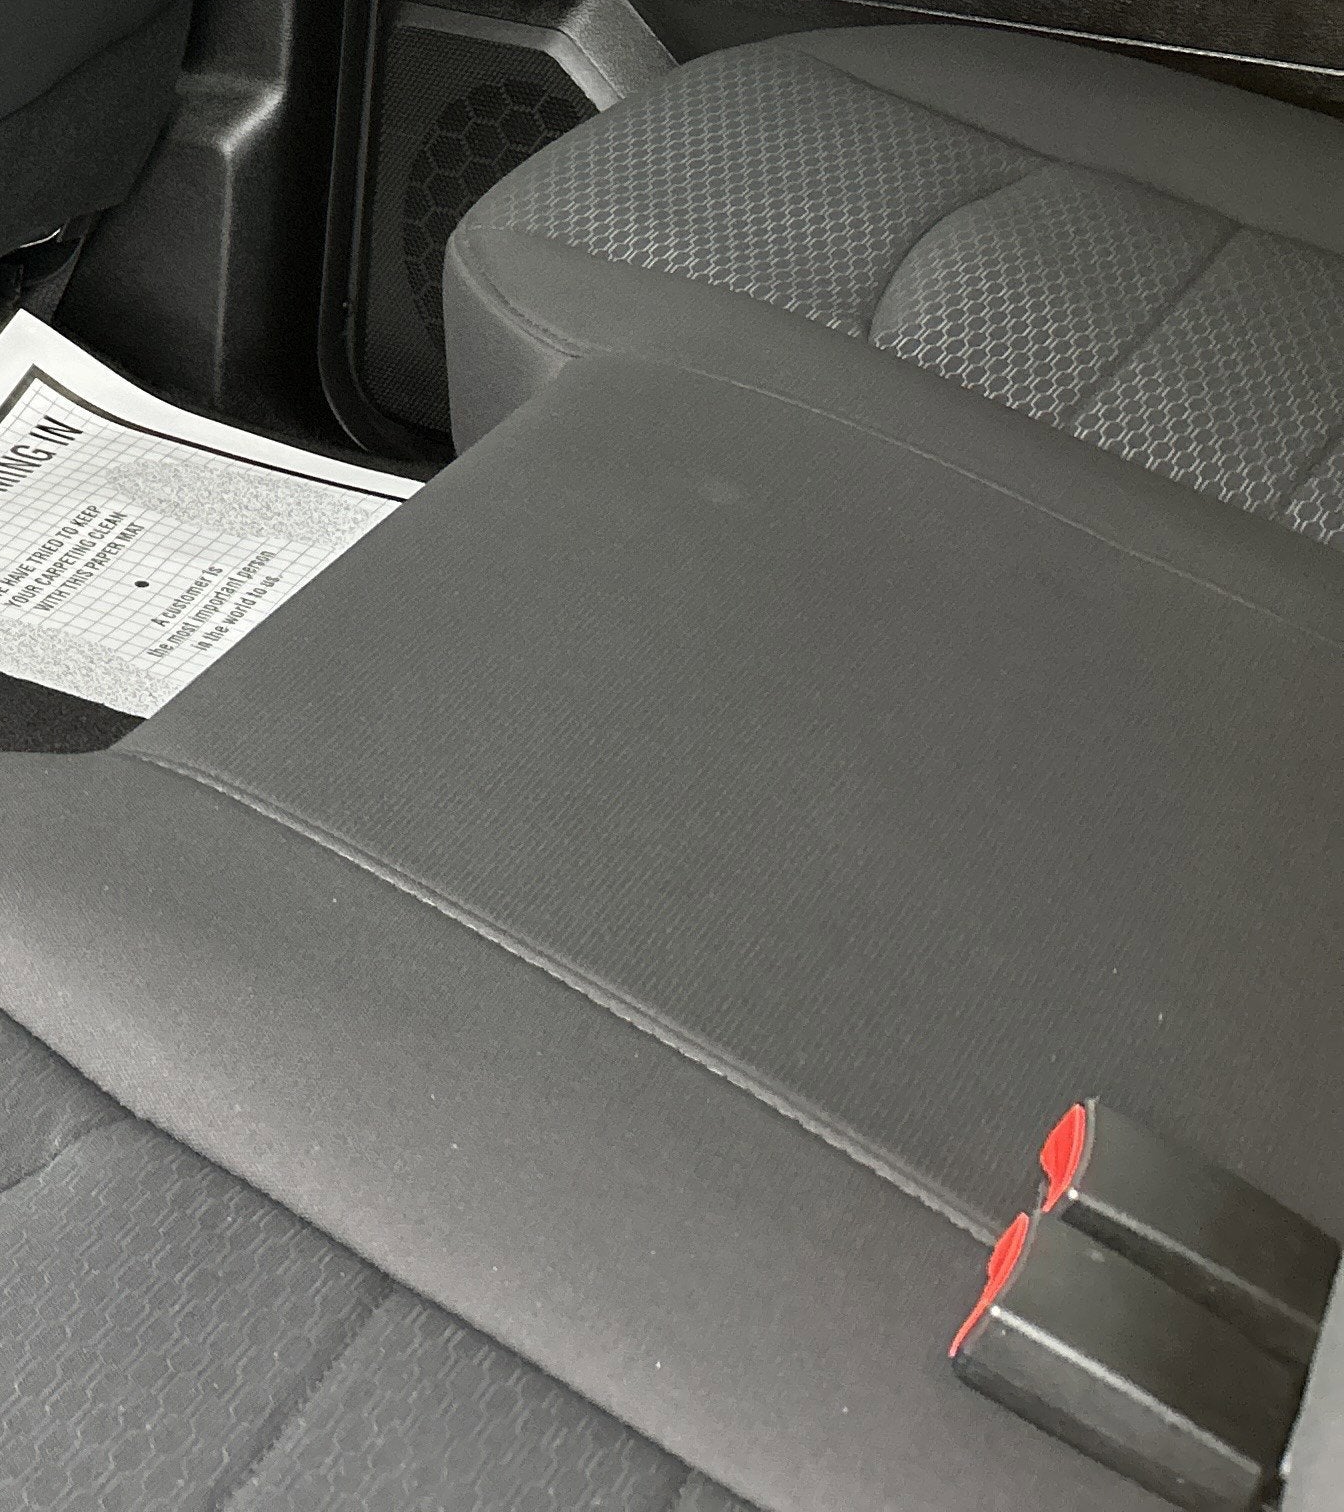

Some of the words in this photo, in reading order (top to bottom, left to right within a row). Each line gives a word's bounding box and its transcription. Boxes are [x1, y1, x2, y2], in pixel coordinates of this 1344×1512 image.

[29, 415, 83, 446] IN
[0, 563, 36, 587] HAVE
[26, 539, 64, 565] TRIED
[55, 526, 79, 540] TO
[70, 505, 101, 528] KEEP
[4, 584, 44, 608] YOUR
[34, 538, 96, 586] CARPETING
[88, 511, 128, 540] CLEAN
[33, 586, 71, 612] WITH
[62, 569, 94, 590] THIS
[84, 541, 125, 570] PAPER
[115, 522, 145, 543] MAT
[146, 644, 174, 658] the
[166, 622, 200, 646] most
[192, 577, 245, 623] important
[237, 550, 276, 579] person
[151, 616, 170, 627] A
[162, 569, 213, 619] customer
[207, 566, 223, 576] is
[190, 640, 213, 651] in
[204, 626, 229, 642] the
[222, 597, 256, 625] world
[246, 587, 267, 598] to
